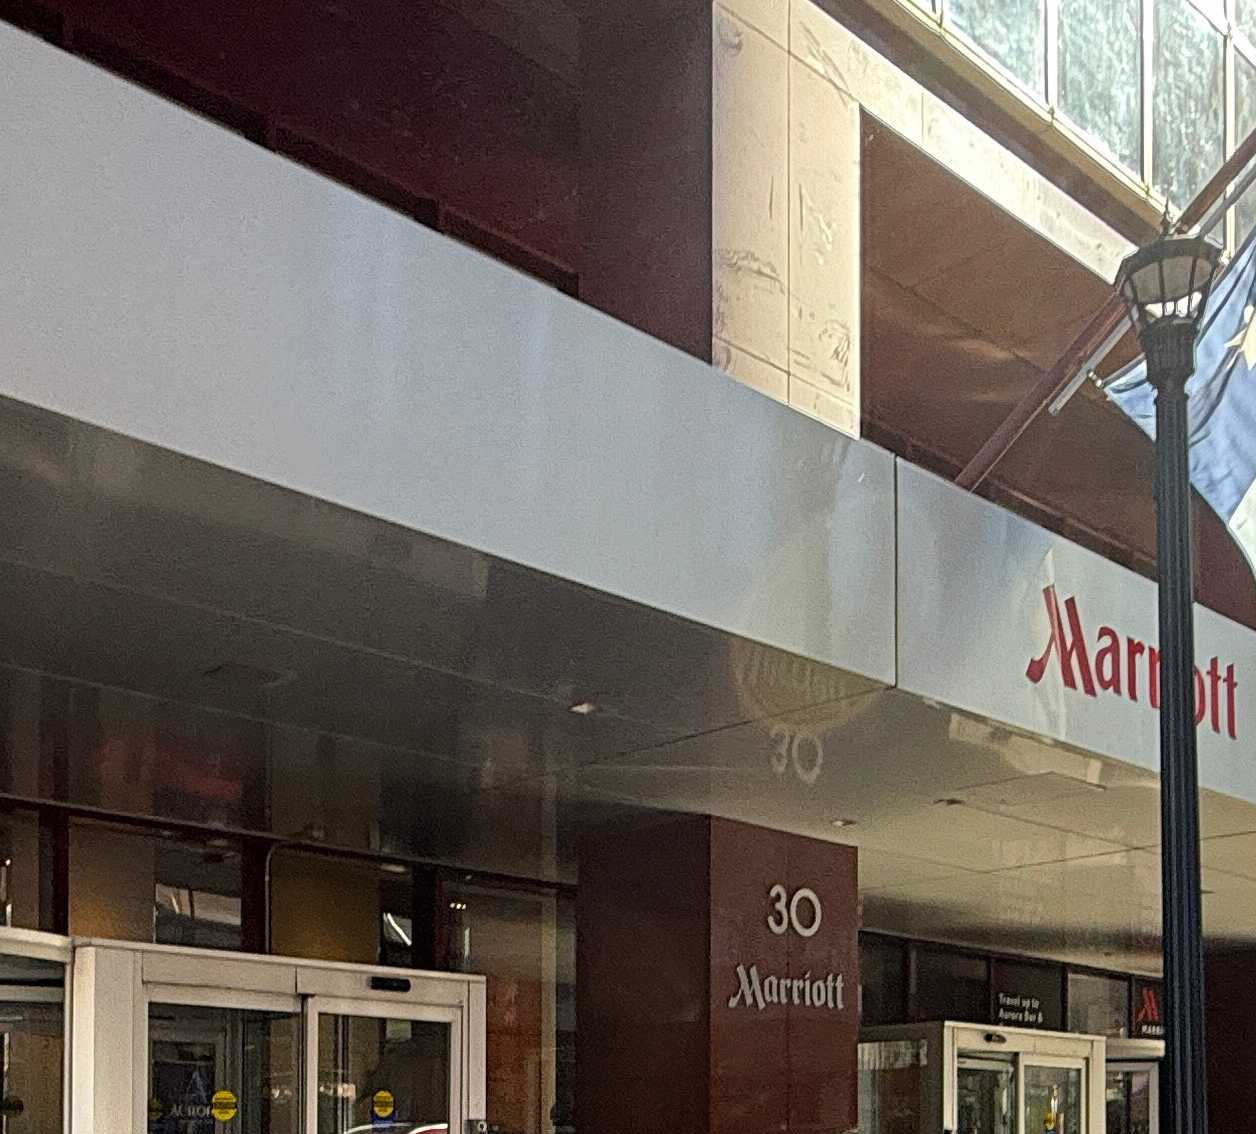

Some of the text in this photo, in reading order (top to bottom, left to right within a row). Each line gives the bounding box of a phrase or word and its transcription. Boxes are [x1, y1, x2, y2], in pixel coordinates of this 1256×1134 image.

[1025, 583, 1239, 740] Marrtt
[767, 884, 822, 937] 30
[728, 964, 844, 1010] Marriott
